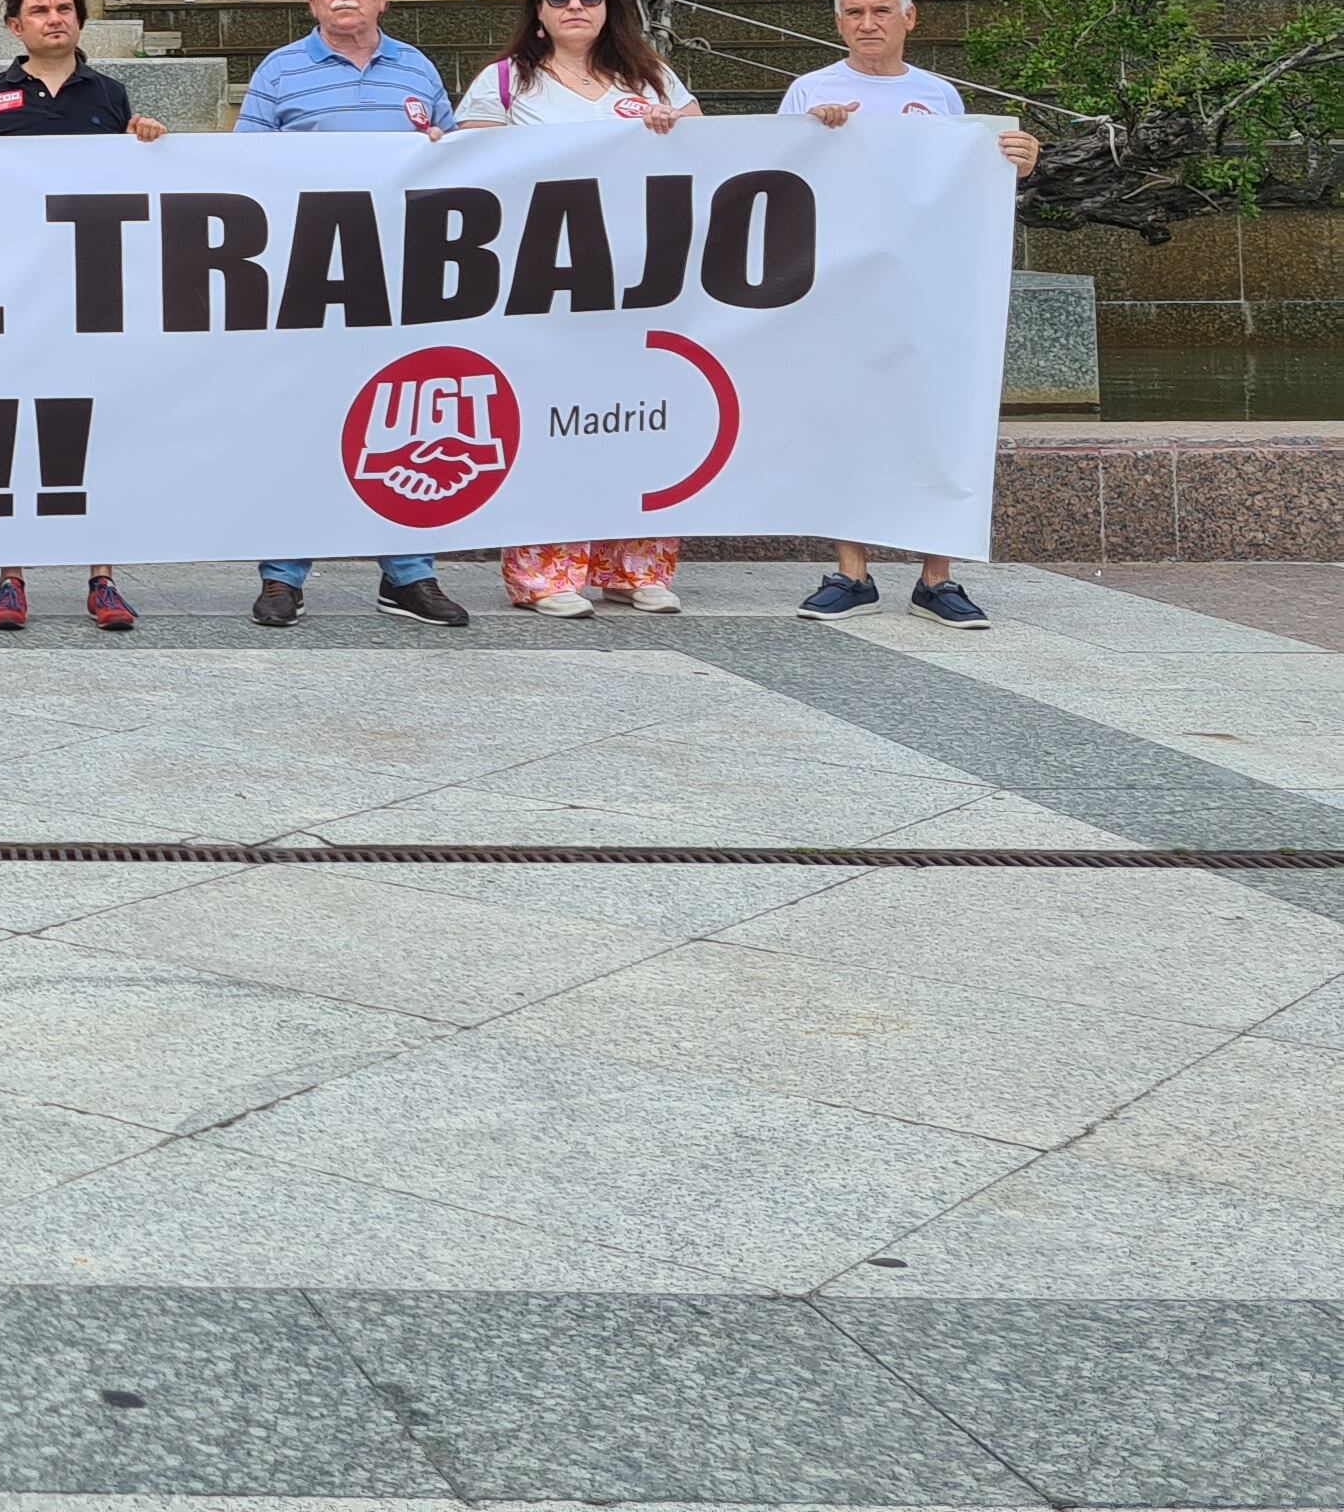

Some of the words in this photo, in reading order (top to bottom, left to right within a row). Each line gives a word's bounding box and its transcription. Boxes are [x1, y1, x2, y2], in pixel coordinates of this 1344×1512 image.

[45, 169, 818, 334] TRABAJO
[365, 373, 499, 446] UGT
[549, 399, 668, 437] Madrid
